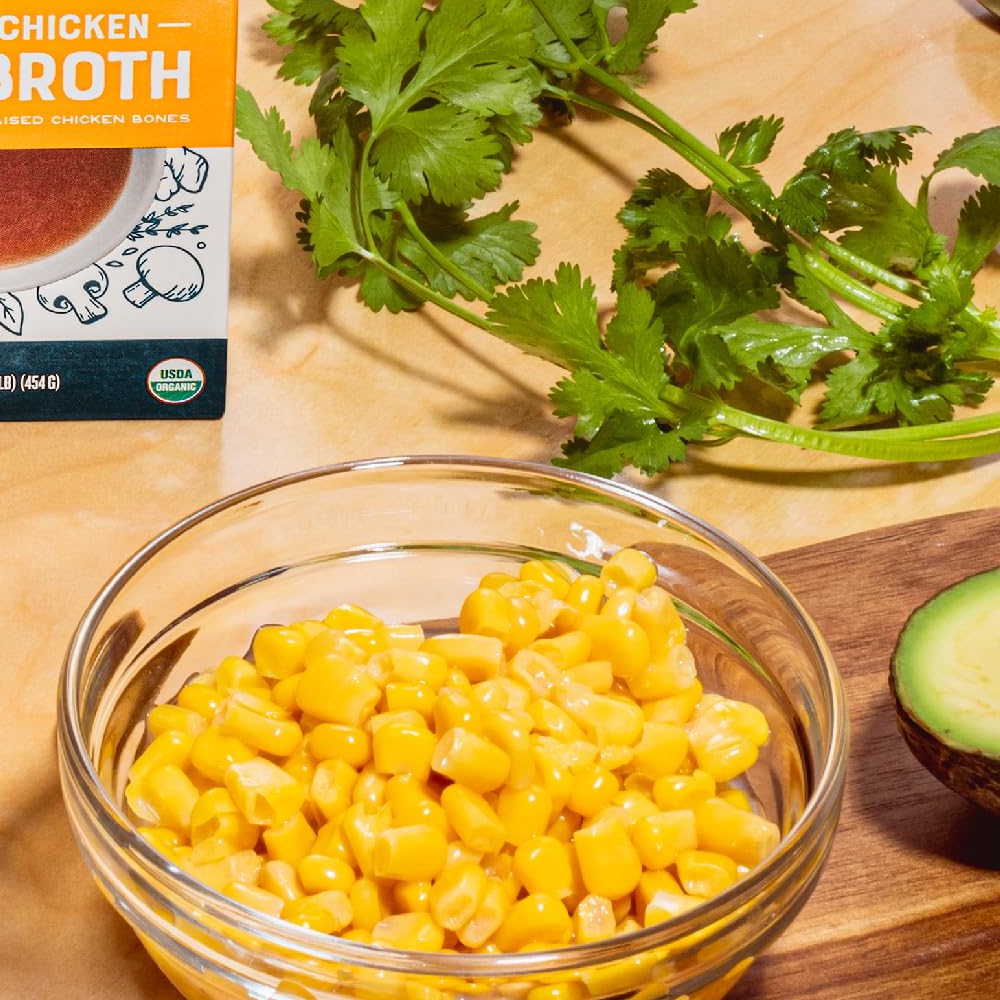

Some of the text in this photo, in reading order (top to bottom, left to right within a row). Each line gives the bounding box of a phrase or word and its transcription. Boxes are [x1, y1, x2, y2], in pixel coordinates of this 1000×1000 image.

[51, 114, 126, 125] CHICKEN
[131, 113, 192, 124] BONES
[160, 369, 193, 379] USDA
[156, 382, 197, 391] ORGANIC
